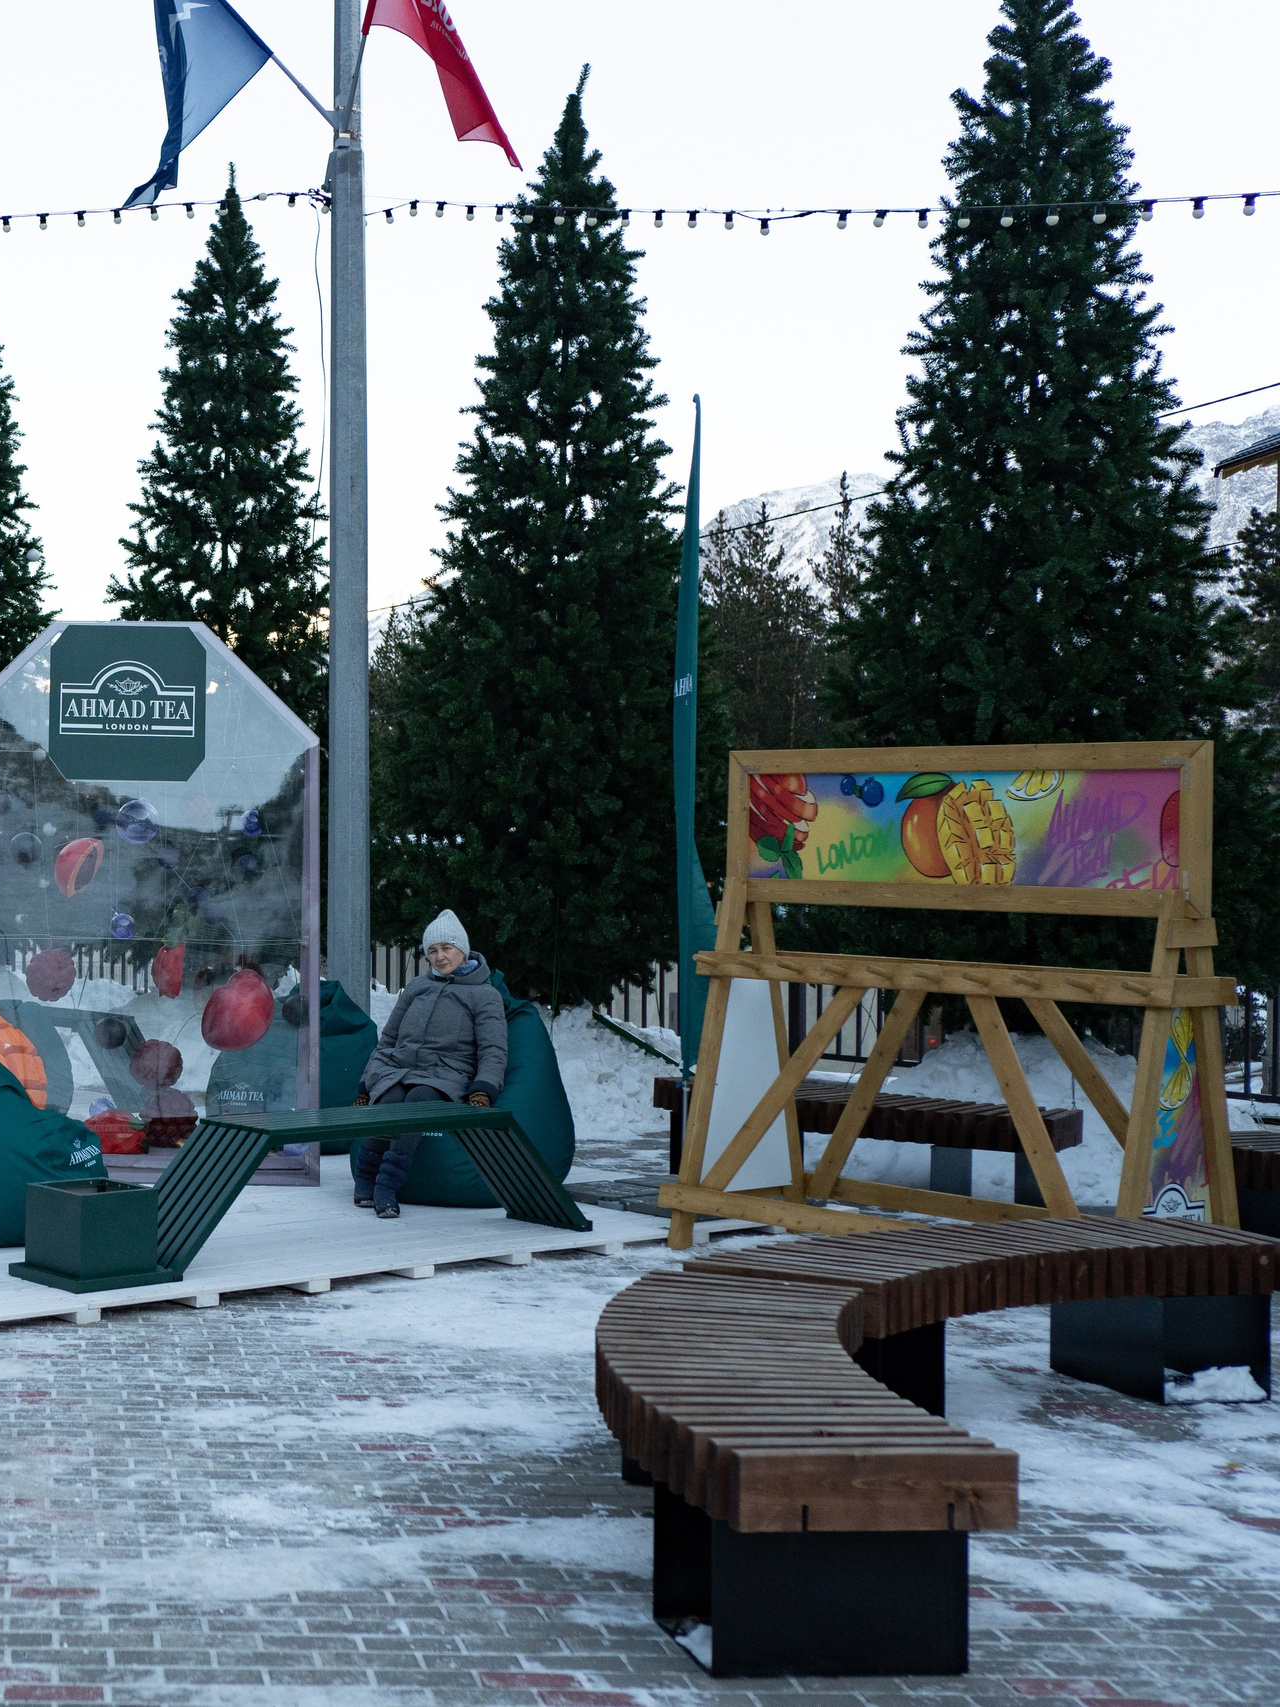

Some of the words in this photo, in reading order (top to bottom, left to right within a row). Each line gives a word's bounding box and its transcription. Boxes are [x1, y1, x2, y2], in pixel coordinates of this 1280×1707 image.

[65, 698, 146, 720] AHMAD
[150, 700, 191, 720] TEA
[105, 723, 150, 731] LONDON
[815, 821, 894, 875] LONDON
[217, 1090, 247, 1101] AHMAD
[248, 1091, 264, 1102] TEA
